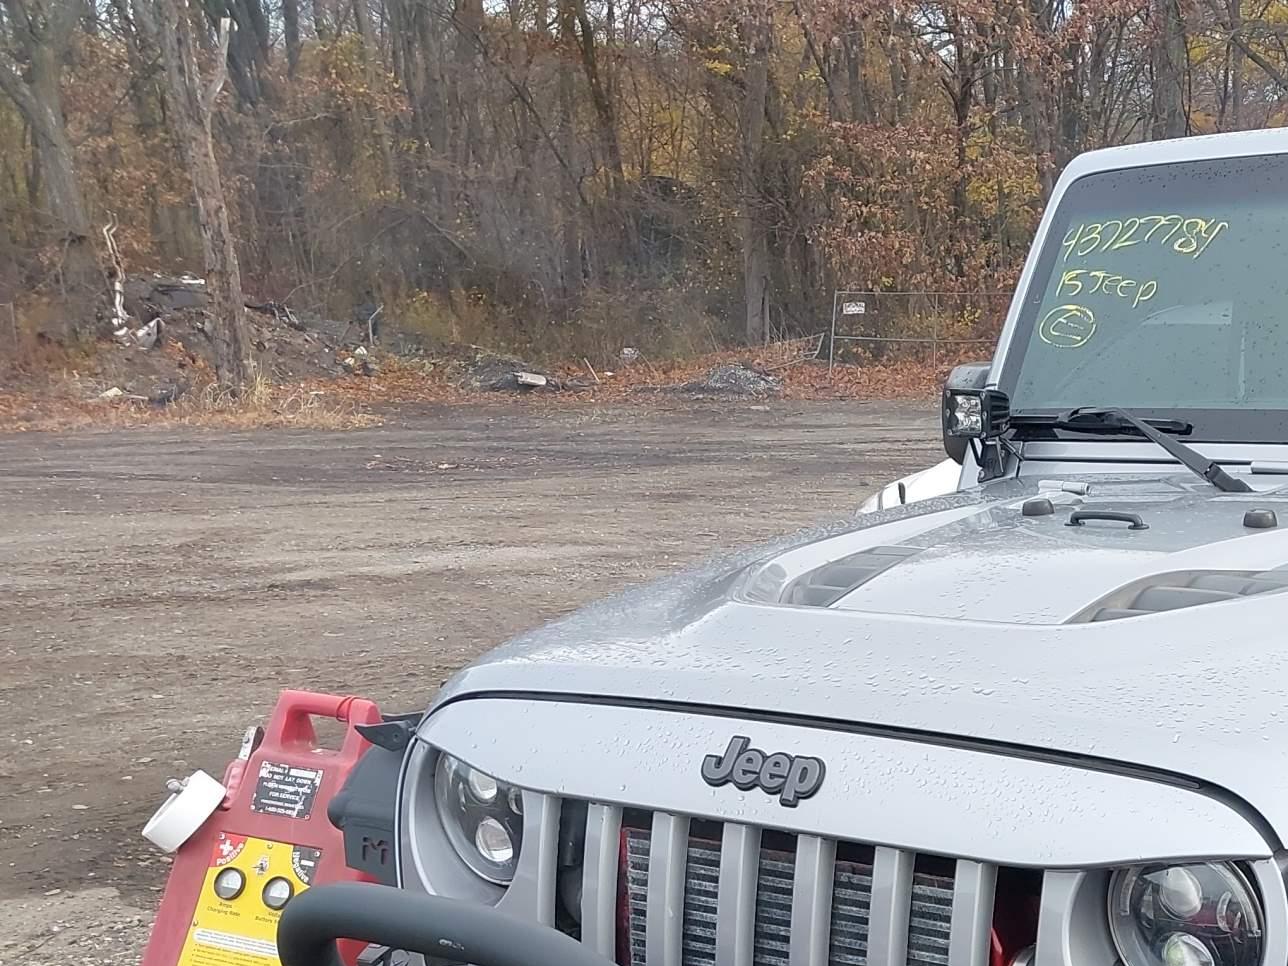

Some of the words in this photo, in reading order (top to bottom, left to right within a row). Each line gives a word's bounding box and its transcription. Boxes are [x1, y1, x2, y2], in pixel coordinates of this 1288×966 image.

[701, 735, 826, 808] Jeep
[216, 842, 245, 867] Positive
[292, 851, 309, 883] Negative
